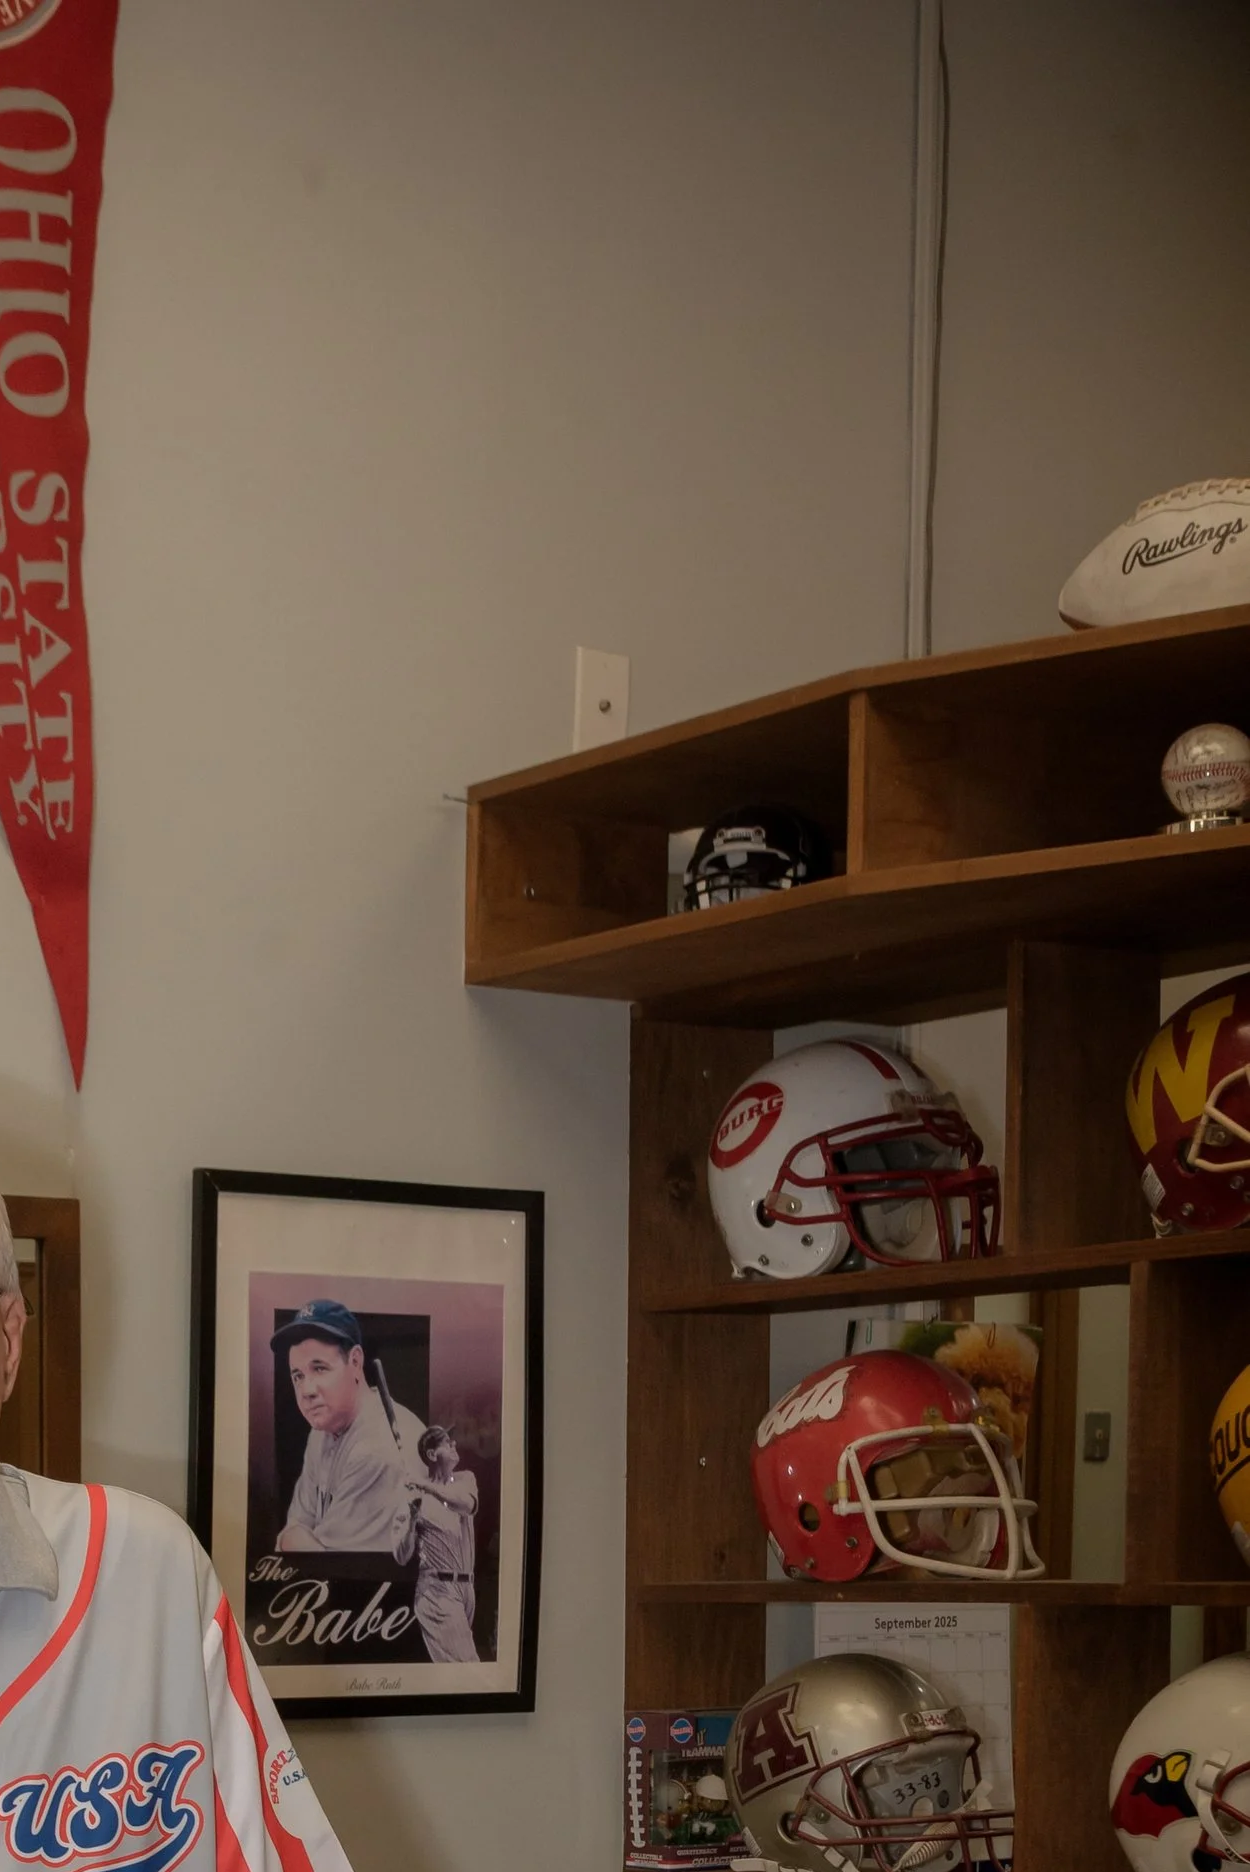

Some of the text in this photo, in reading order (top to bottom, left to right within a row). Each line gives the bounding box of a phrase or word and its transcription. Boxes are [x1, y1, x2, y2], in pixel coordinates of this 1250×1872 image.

[1122, 517, 1248, 575] Rawlings
[10, 470, 74, 841] STATE
[249, 1555, 300, 1582] The
[253, 1579, 418, 1646] Babe
[874, 1615, 958, 1633] September 2025
[346, 1676, 402, 1691] Babe Ruth
[732, 1683, 821, 1805] A
[269, 1750, 288, 1804] SPORT
[893, 1771, 941, 1804] 33-83
